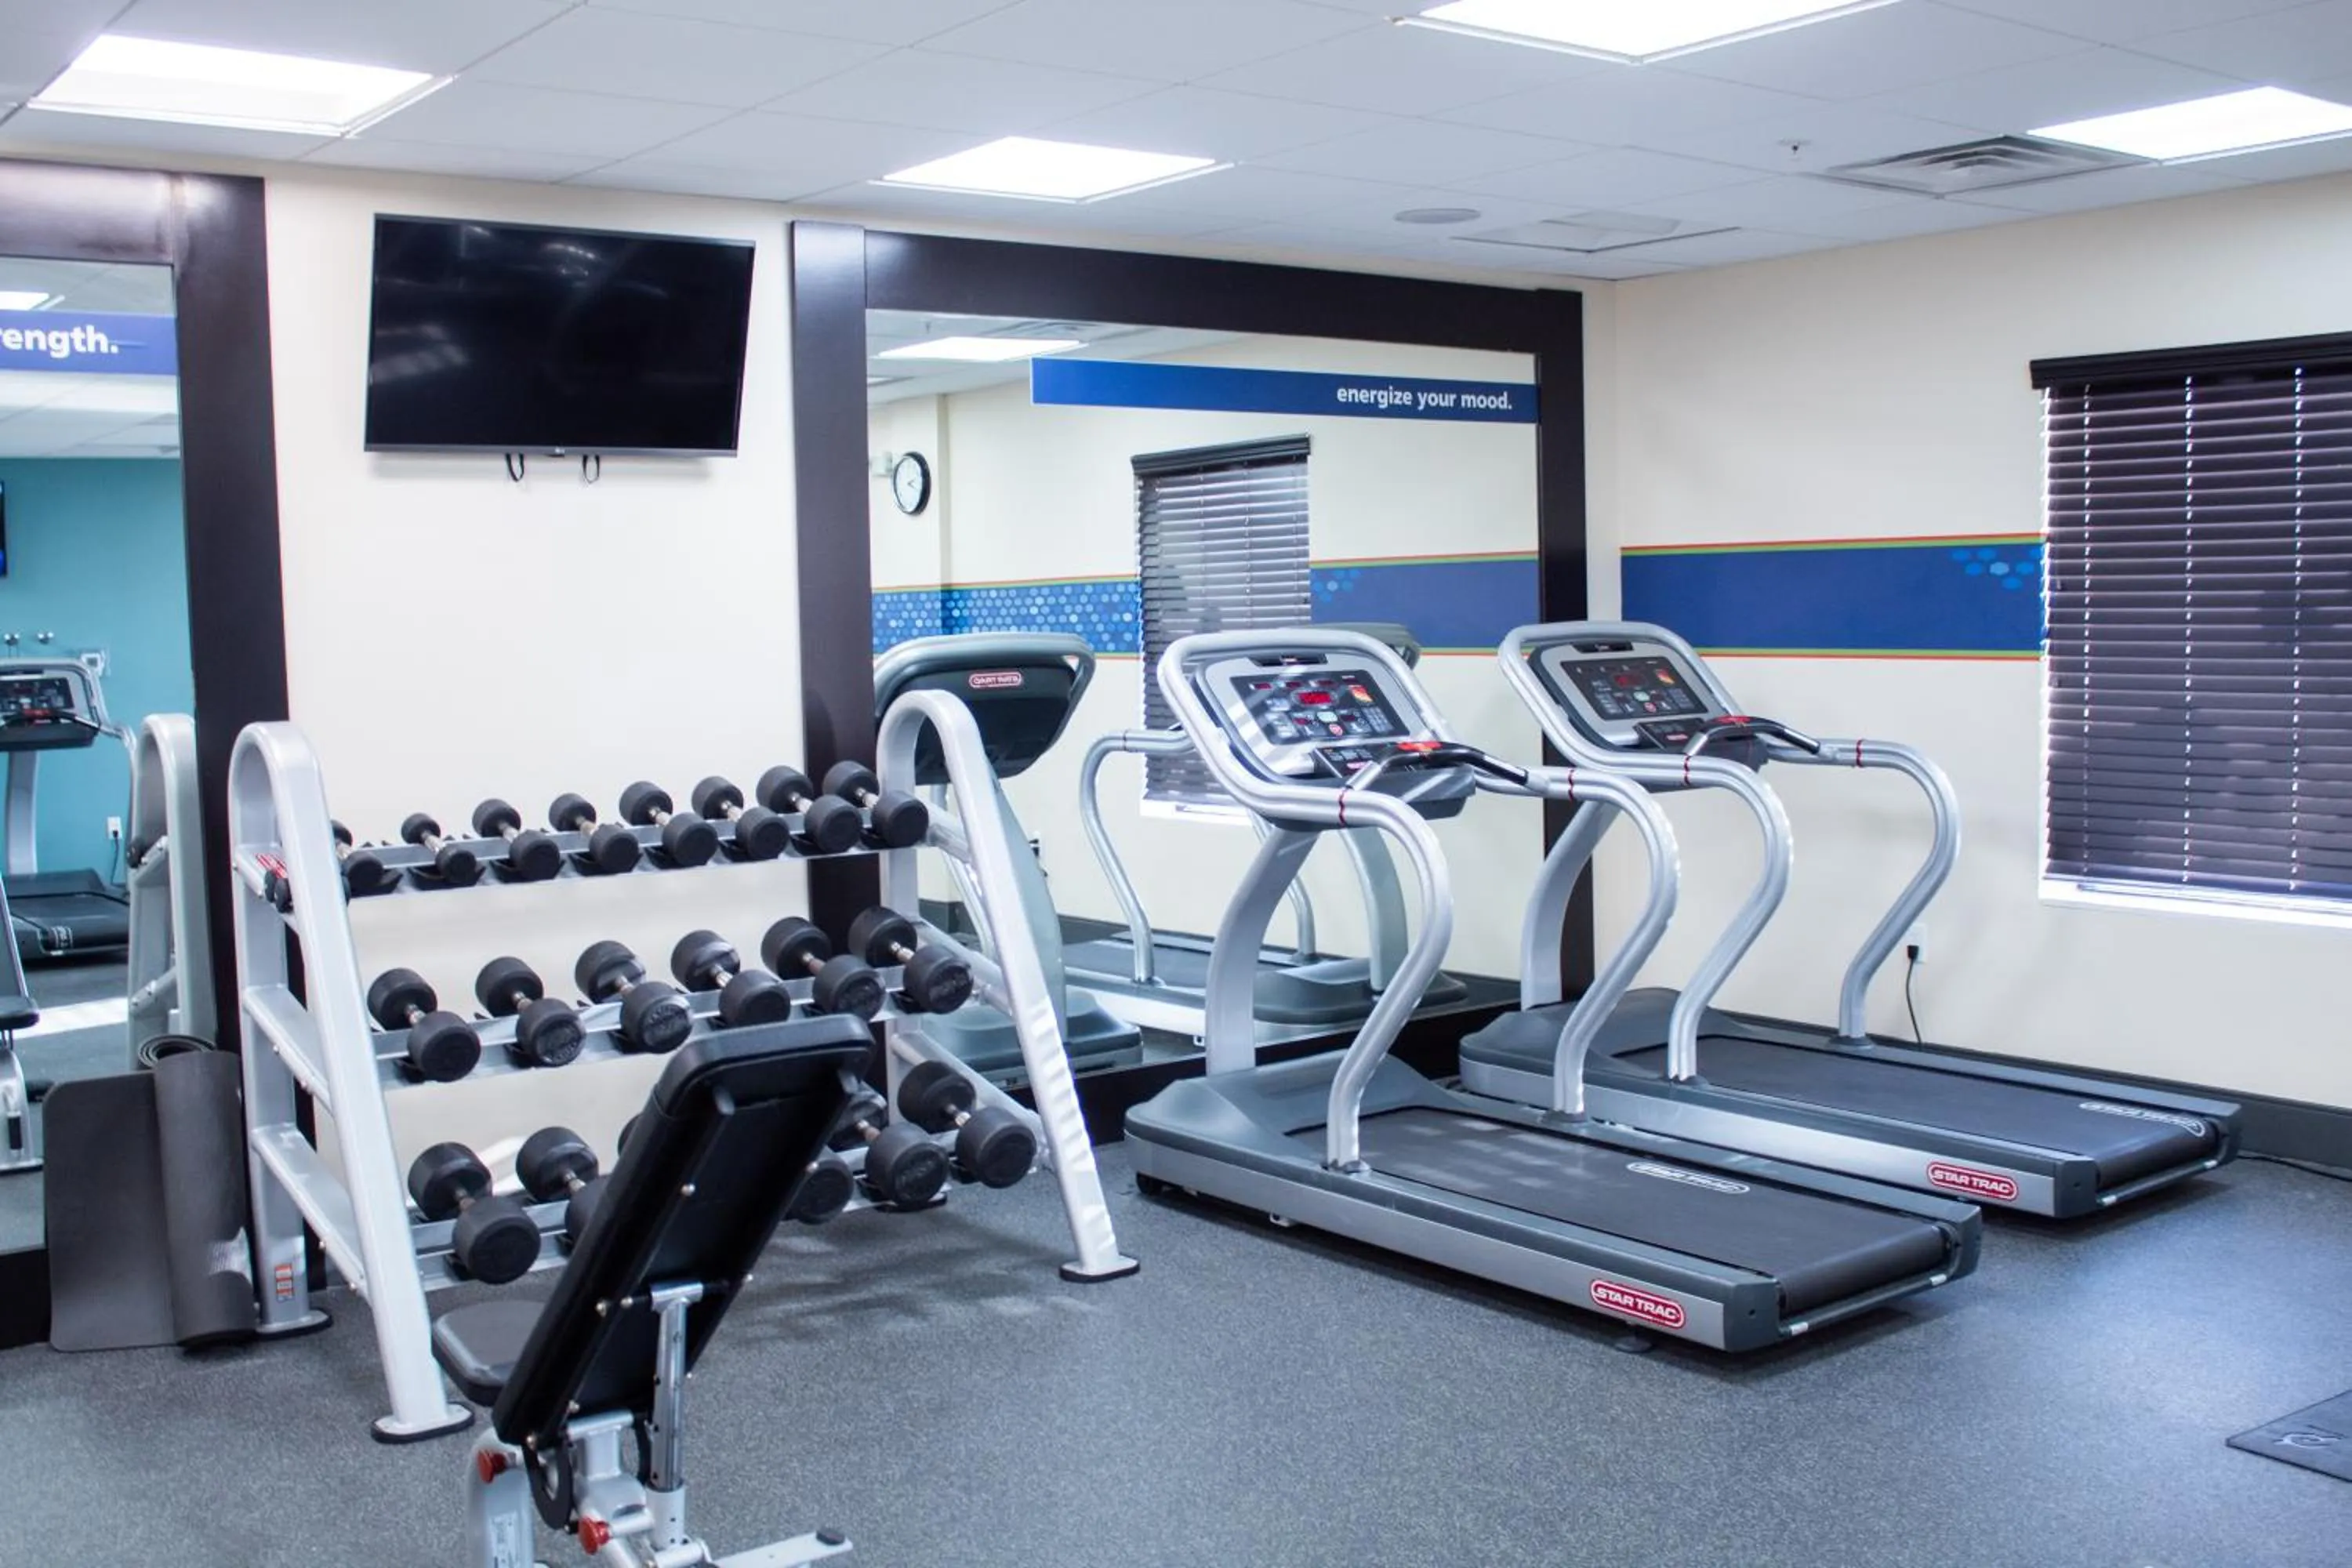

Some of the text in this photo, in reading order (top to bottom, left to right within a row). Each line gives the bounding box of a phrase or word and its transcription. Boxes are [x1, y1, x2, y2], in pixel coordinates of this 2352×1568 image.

[0, 324, 119, 358] ength.
[1337, 386, 1513, 410] energize your mood.
[1933, 1169, 2012, 1193] STAR TRAC
[1595, 1287, 1678, 1320] STAR TRAC
